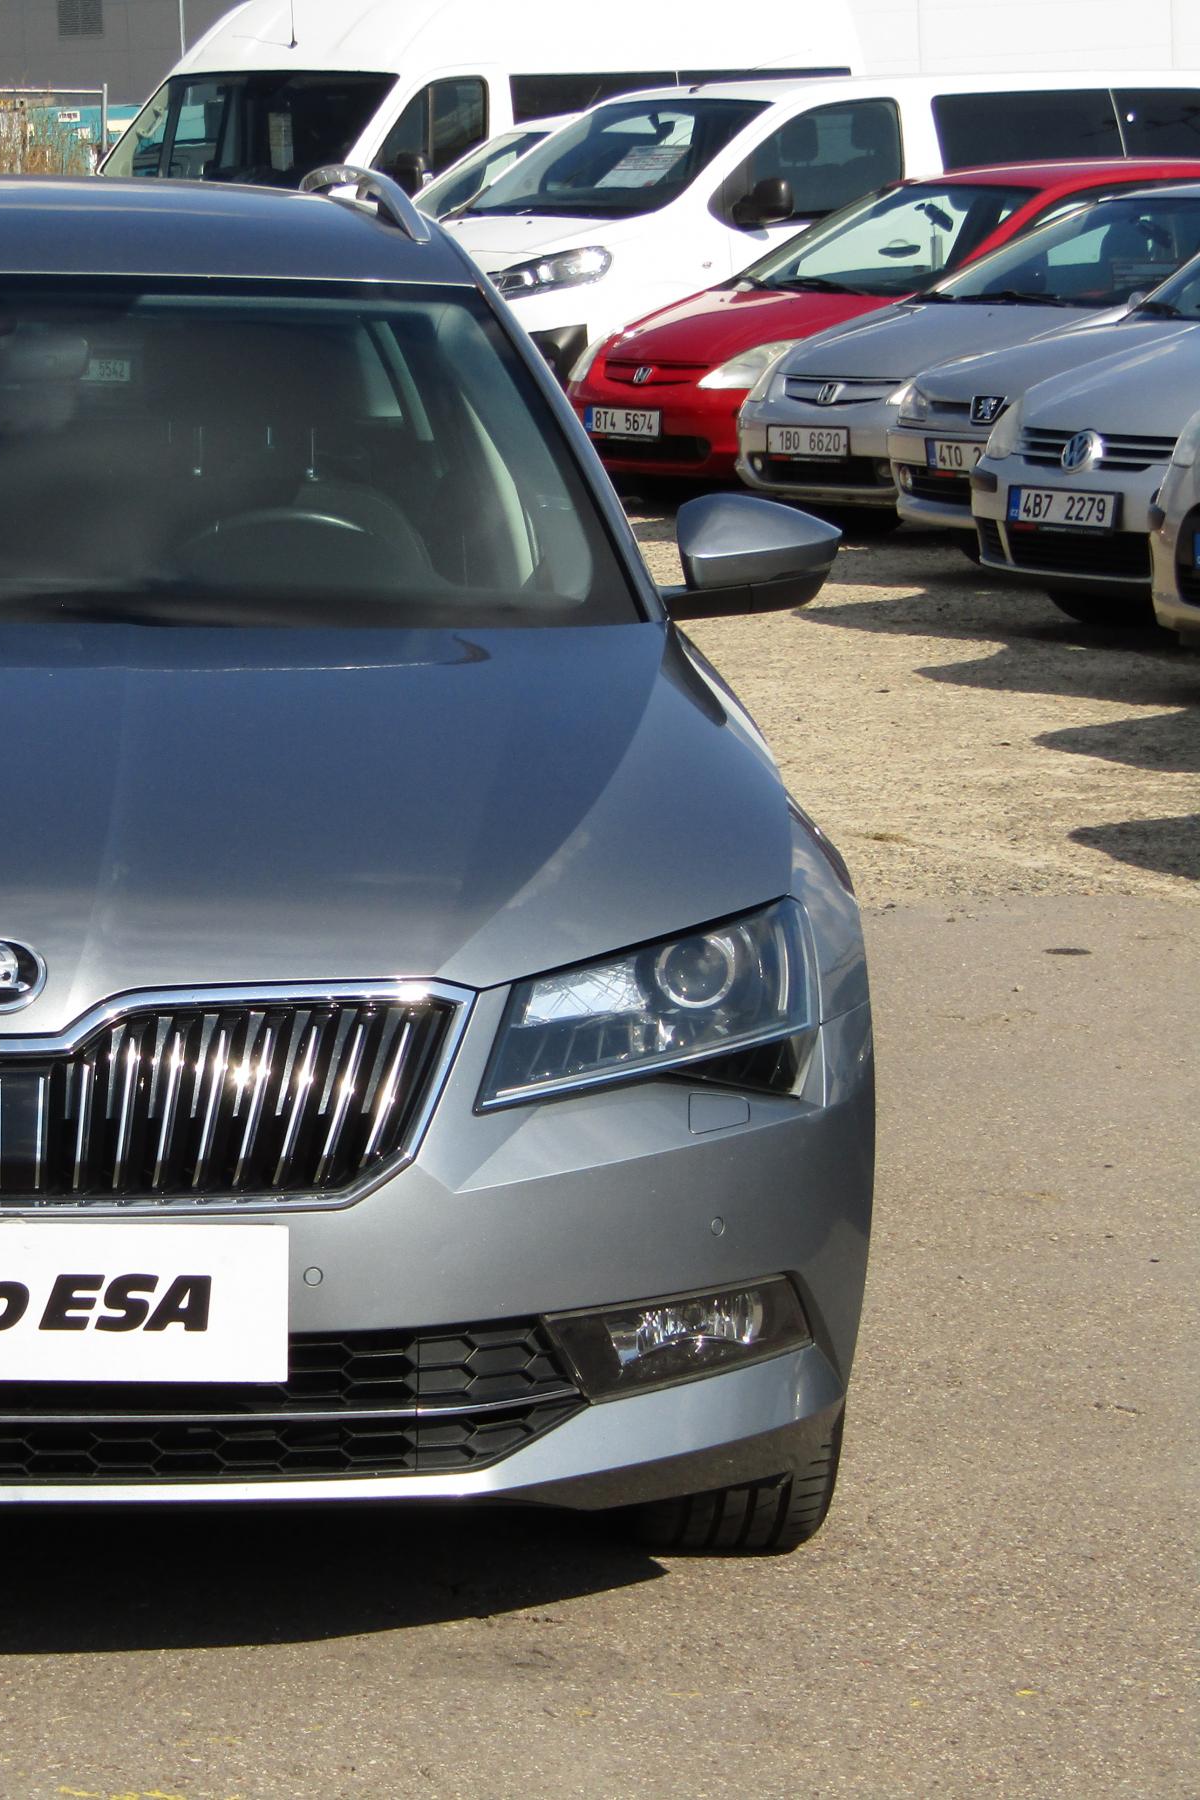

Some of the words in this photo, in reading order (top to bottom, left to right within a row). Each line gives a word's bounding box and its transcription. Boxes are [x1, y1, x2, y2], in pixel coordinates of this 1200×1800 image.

[595, 410, 617, 430] 8T4
[625, 412, 653, 432] 5674
[809, 431, 841, 452] 6620
[1022, 493, 1054, 519] 4B7
[1064, 496, 1106, 522] 2279
[38, 1273, 213, 1332] ESA
